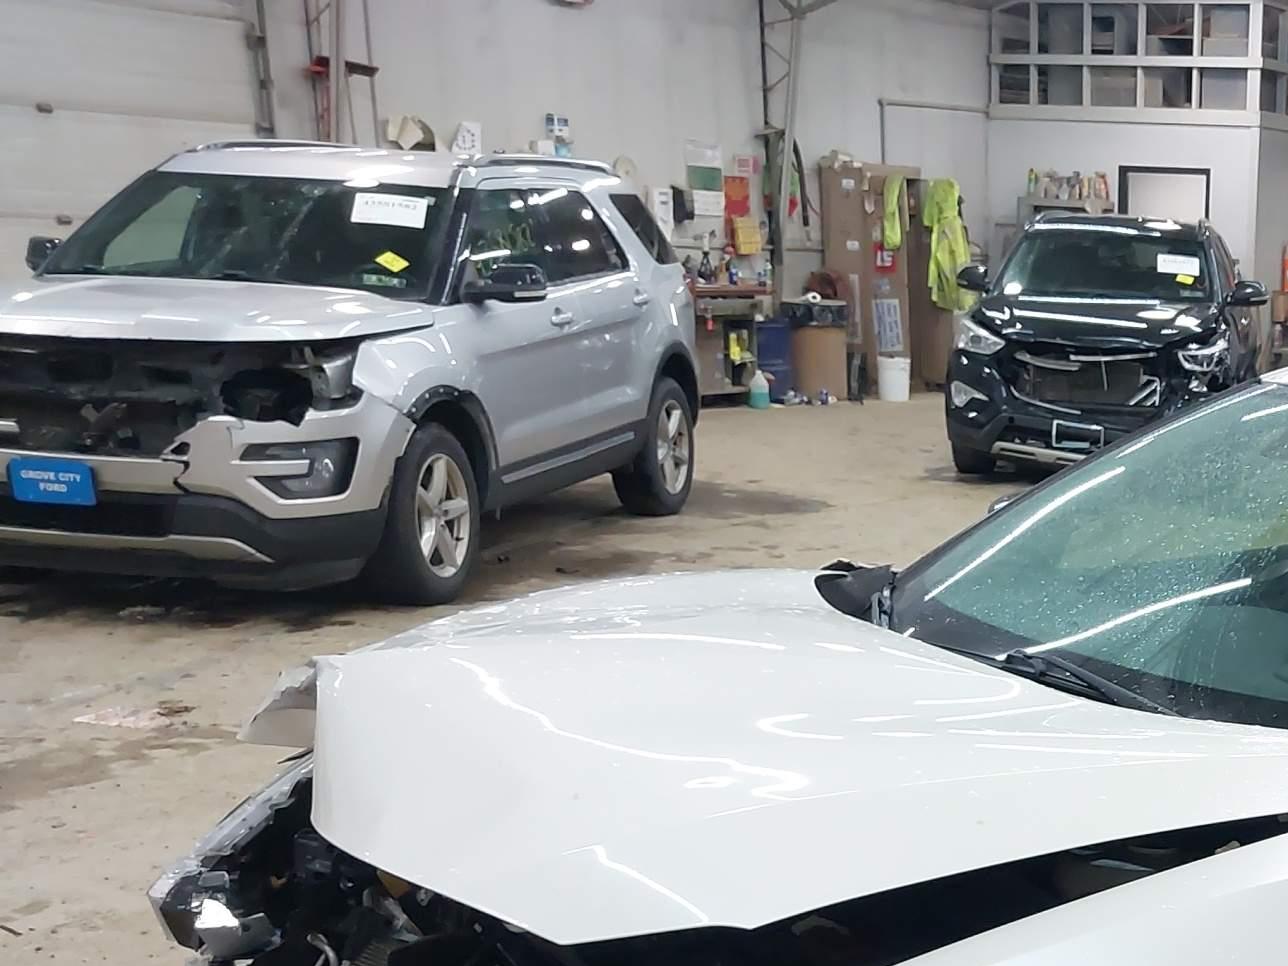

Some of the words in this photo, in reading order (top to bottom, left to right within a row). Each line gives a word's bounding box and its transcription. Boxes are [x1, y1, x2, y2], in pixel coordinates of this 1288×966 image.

[20, 469, 56, 481] GROVE
[58, 472, 81, 482] CITY
[38, 482, 68, 493] FORD
